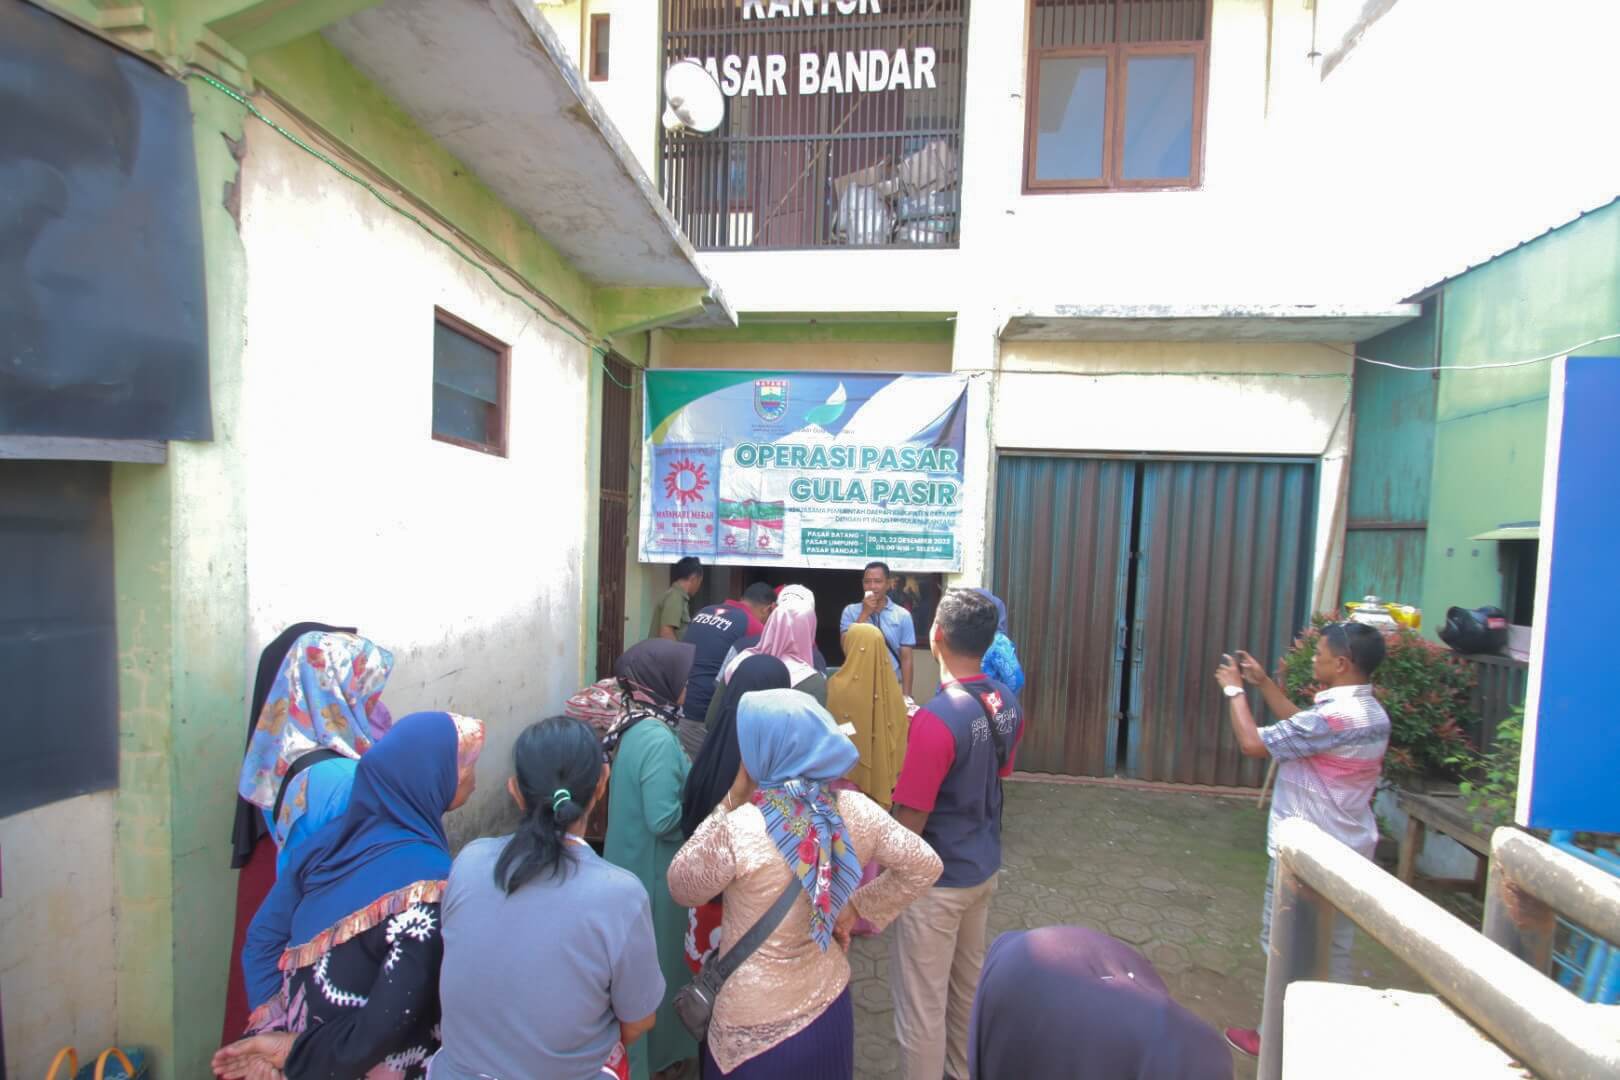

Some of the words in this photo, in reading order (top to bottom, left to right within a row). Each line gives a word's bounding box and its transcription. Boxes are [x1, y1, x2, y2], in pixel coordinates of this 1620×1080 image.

[684, 54, 786, 97] SAR
[799, 47, 937, 95] BANDAR
[735, 442, 855, 470] OPERASI
[861, 445, 959, 473] PASAR
[790, 477, 867, 503] GULA
[871, 479, 958, 506] PASIR
